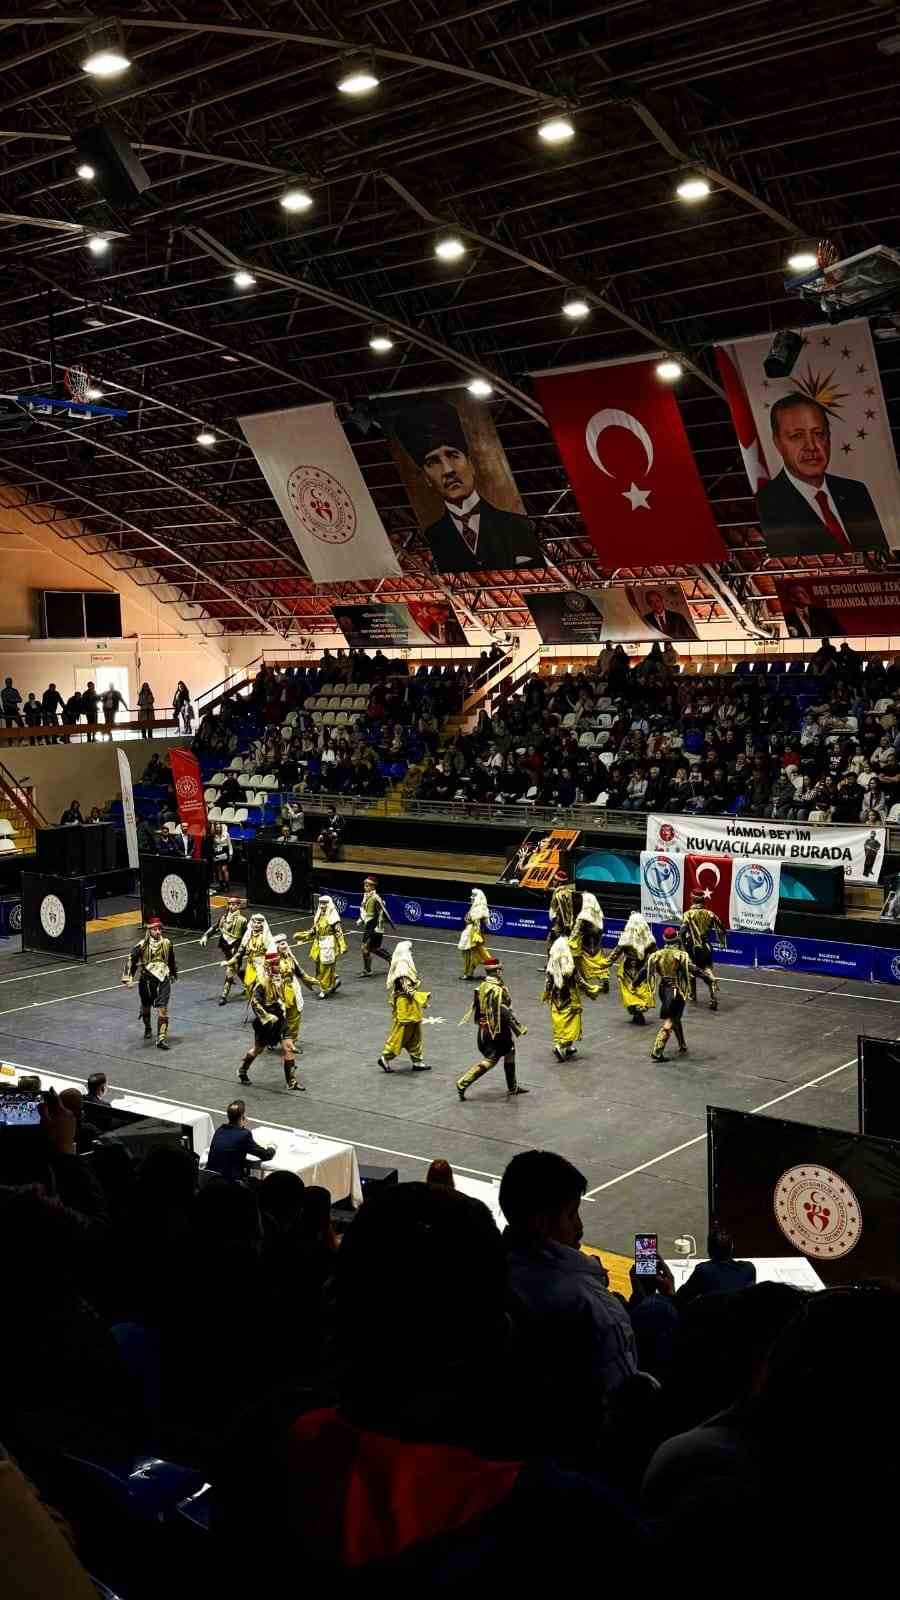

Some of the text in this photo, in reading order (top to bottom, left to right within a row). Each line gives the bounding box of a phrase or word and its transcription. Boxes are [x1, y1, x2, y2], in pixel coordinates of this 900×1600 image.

[727, 826, 811, 841] HAMDİ BEY'İM
[686, 837, 852, 861] KUVVACILARIN BURADA
